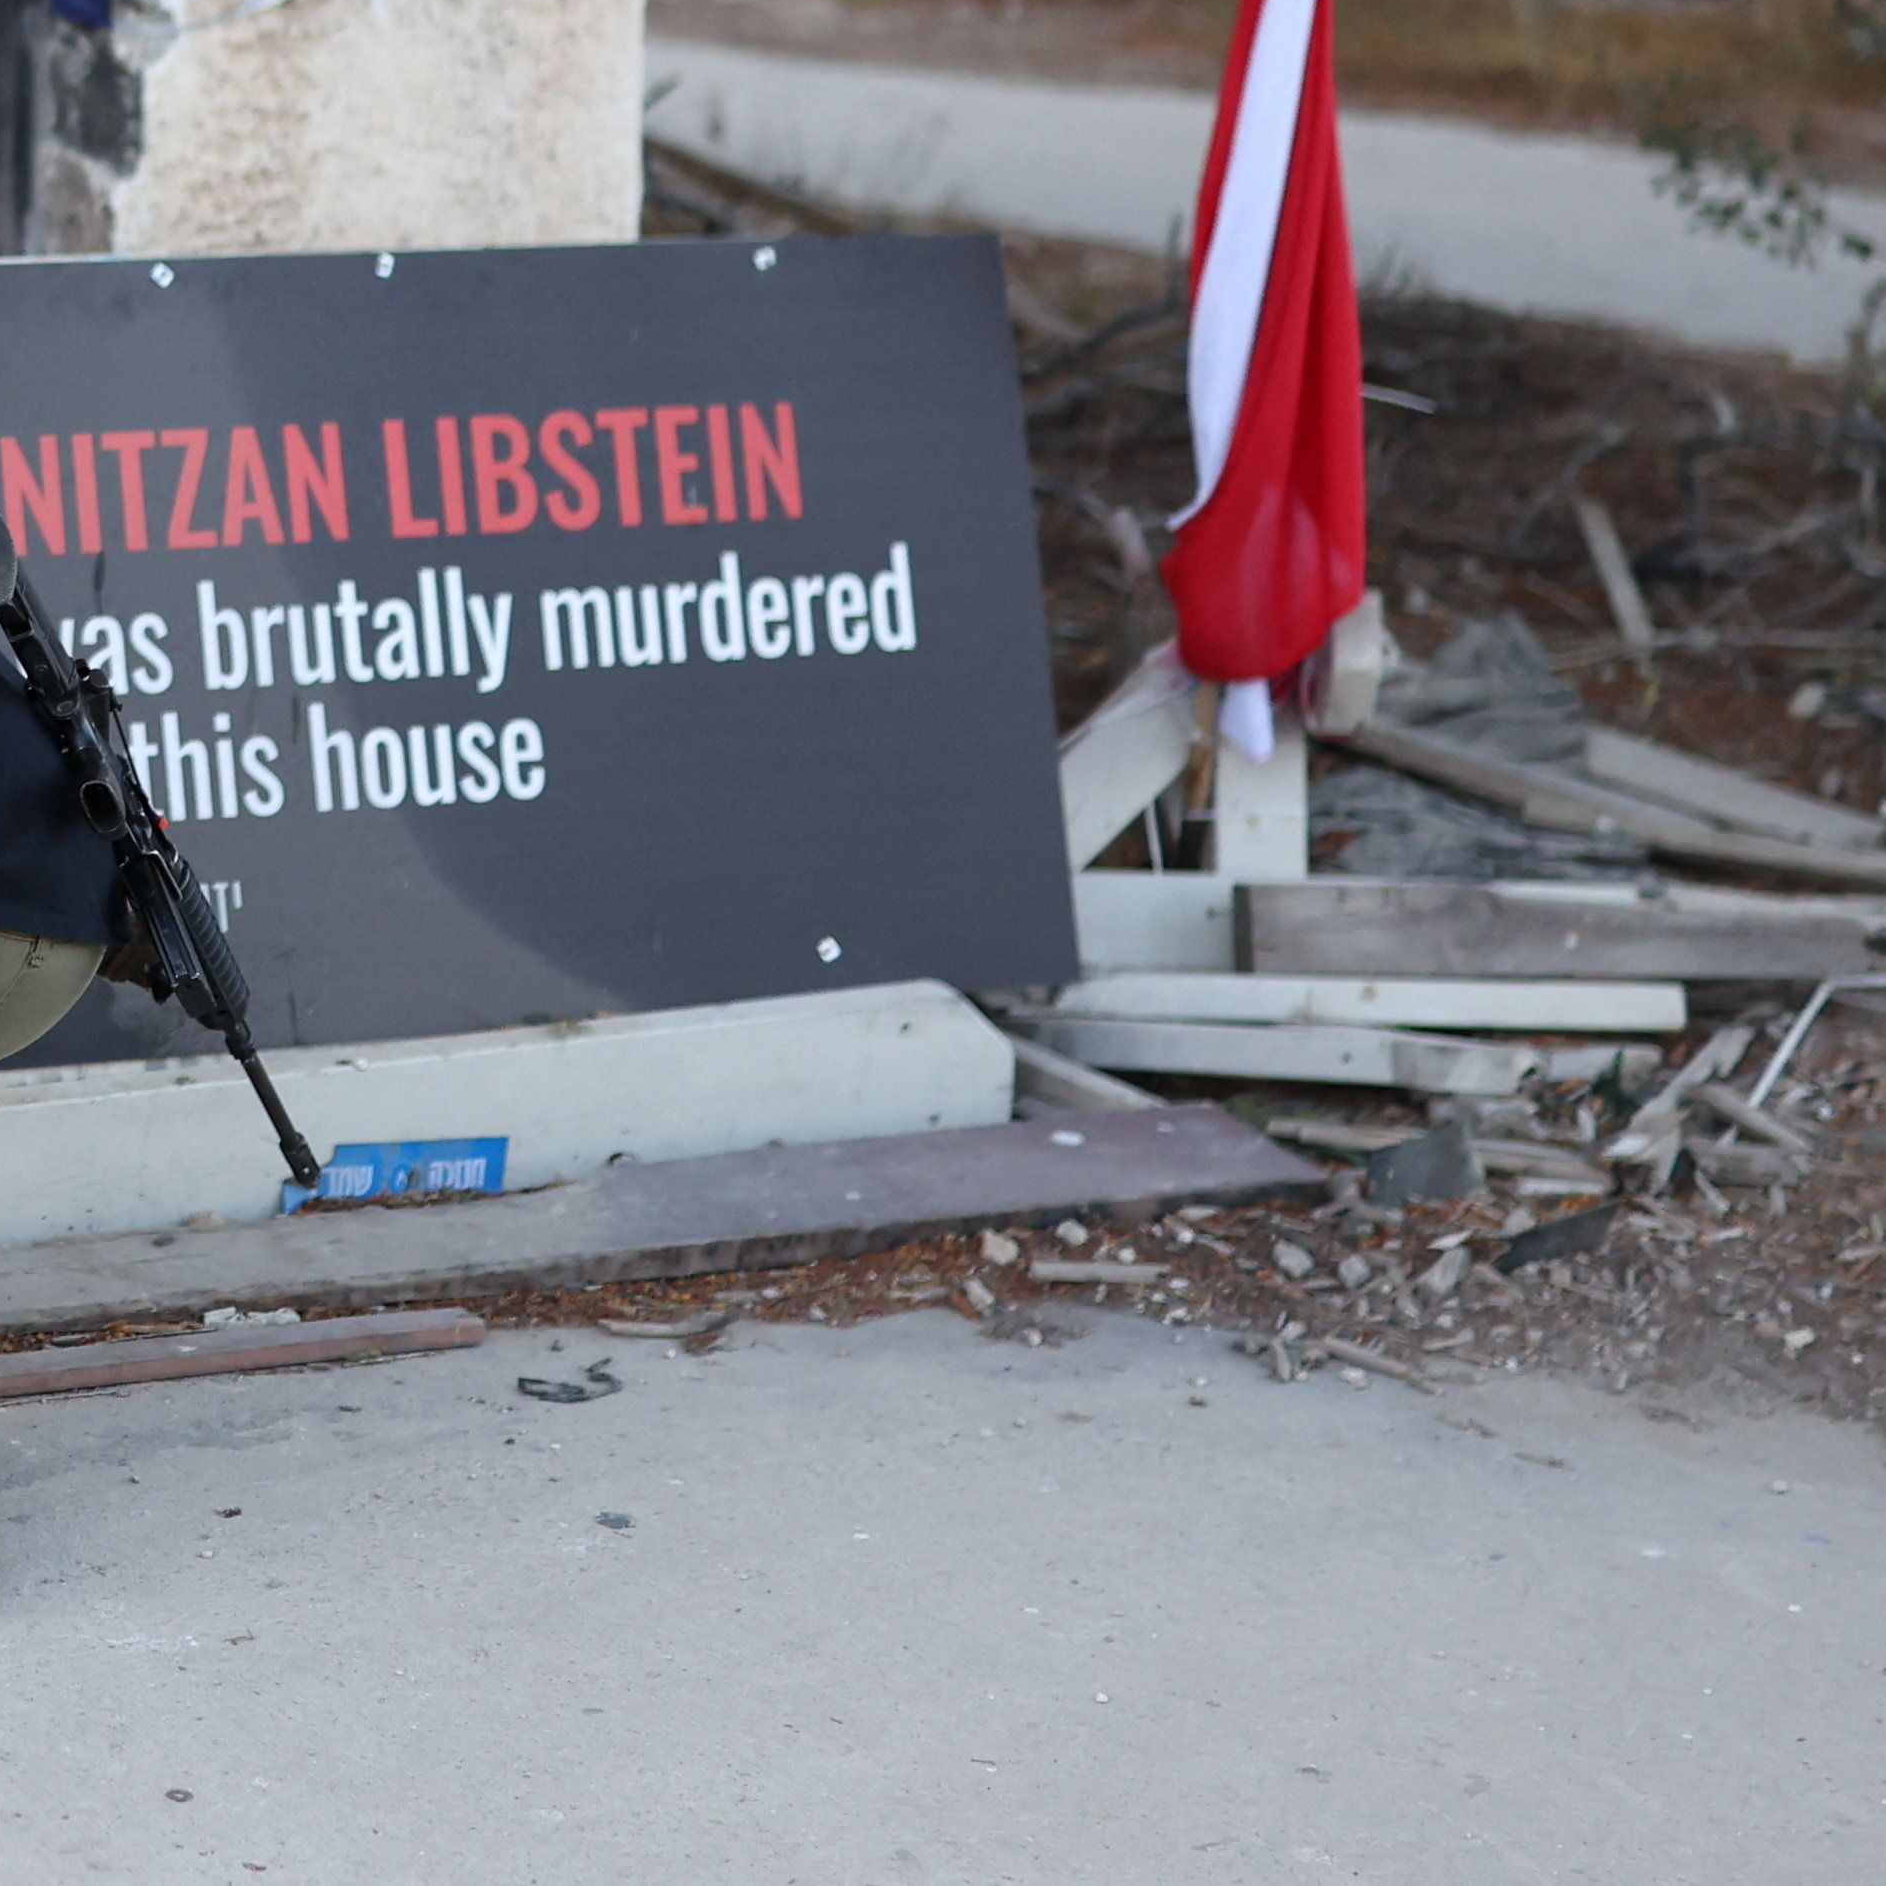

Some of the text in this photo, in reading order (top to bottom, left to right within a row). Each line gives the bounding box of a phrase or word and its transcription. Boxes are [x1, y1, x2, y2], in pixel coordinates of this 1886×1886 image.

[382, 398, 805, 541] LIBSTEIN
[196, 564, 512, 694] brutally
[541, 541, 918, 673] murdered
[127, 701, 547, 823] this house
